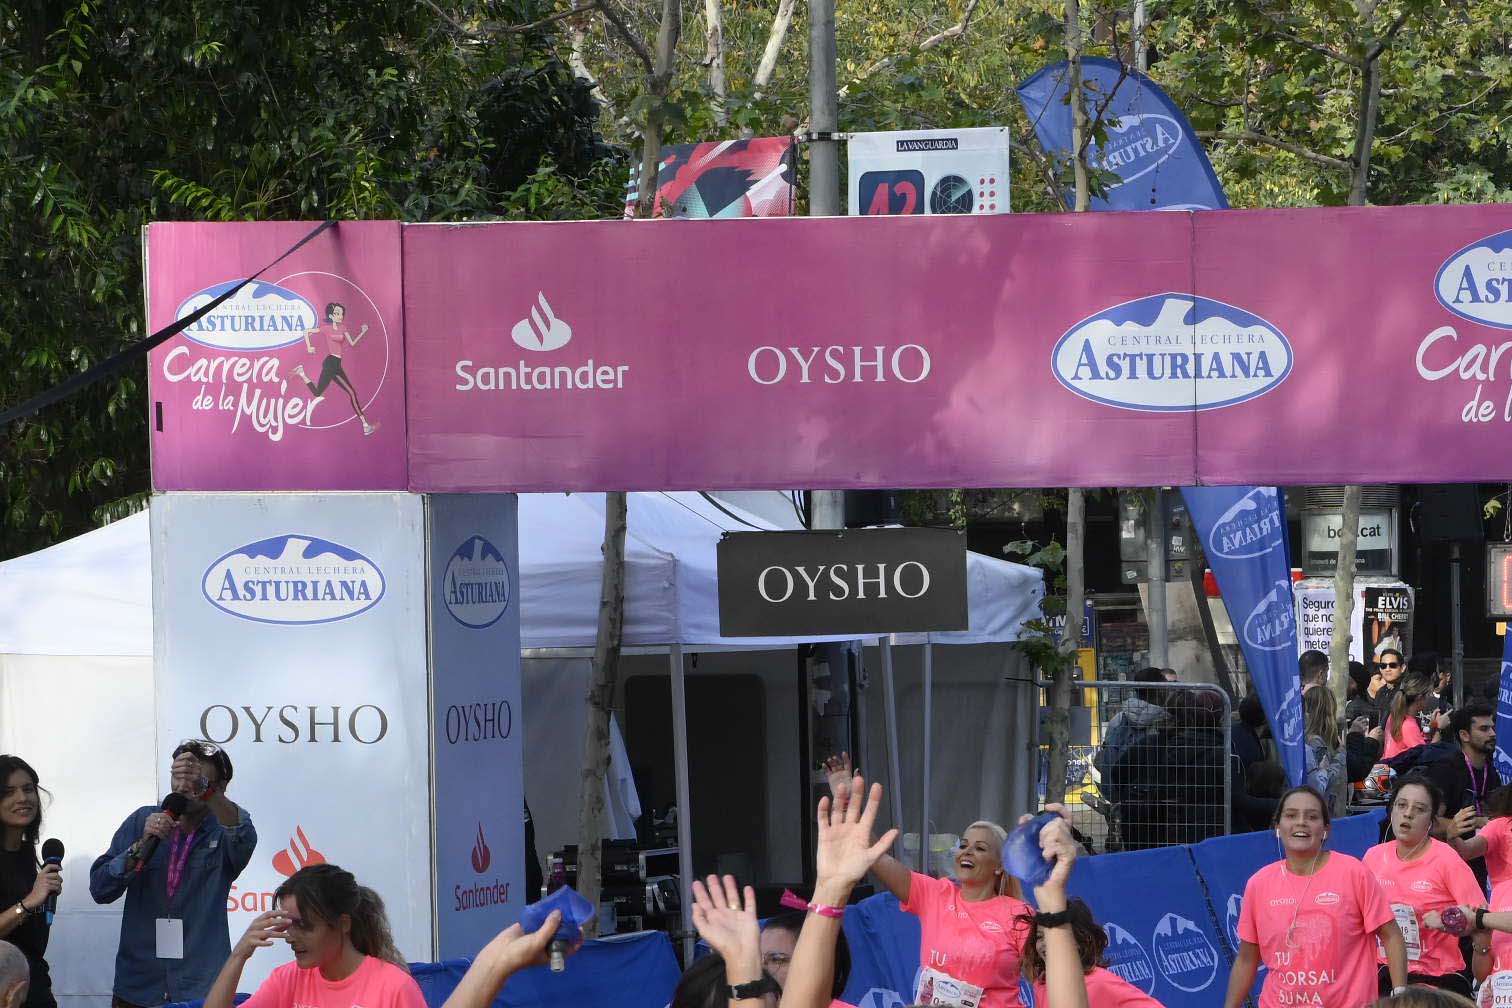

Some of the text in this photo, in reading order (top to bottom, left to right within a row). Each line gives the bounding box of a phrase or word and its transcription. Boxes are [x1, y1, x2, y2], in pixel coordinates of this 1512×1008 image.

[898, 139, 957, 151] LA VANGUARDIA
[1107, 332, 1266, 347] CENTRAL LECHERA
[163, 345, 280, 383] Carrera
[454, 359, 630, 391] Santander
[747, 343, 932, 384] OYSHO
[1070, 338, 1275, 382] ASTURIANA
[192, 381, 325, 442] de la Mujer
[1461, 384, 1496, 423] de
[217, 567, 373, 603] ASTURIANA
[244, 565, 366, 576] CENTRAL LECHERA
[757, 560, 932, 604] OYSHO
[448, 579, 507, 608] ASTURIANA
[1377, 596, 1409, 609] ELVIS
[199, 703, 389, 745] OYSHO
[445, 699, 512, 746] OYSHO
[453, 879, 511, 913] Santander
[929, 949, 947, 967] TU
[1274, 951, 1290, 967] TU
